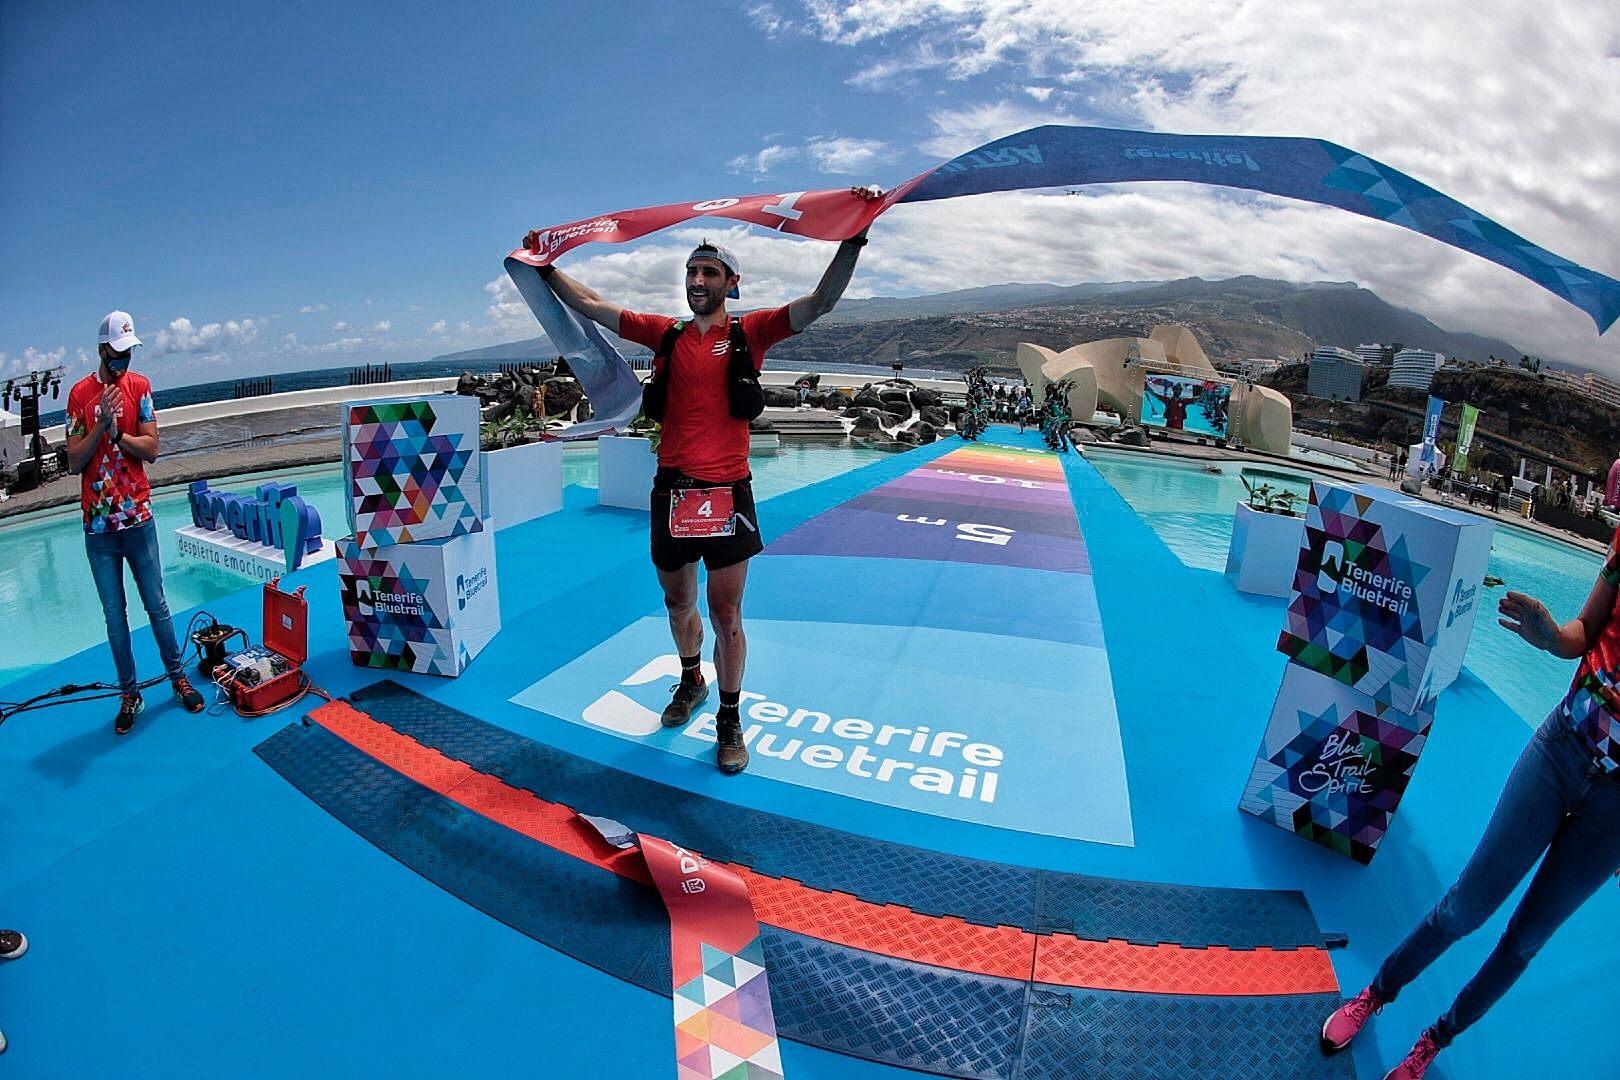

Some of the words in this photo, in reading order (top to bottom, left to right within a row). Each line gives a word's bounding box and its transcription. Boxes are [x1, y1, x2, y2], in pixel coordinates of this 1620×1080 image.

[550, 226, 618, 252] Bluetrail
[551, 217, 619, 240] Tenerife
[697, 500, 712, 518] 4
[178, 537, 220, 564] despierta
[1345, 560, 1412, 599] Tenerife
[372, 590, 424, 604] Tenerife
[374, 601, 425, 616] Bluetrail
[1341, 577, 1409, 617] Bluetrail
[738, 690, 1005, 768] Tenerife
[681, 712, 999, 803] Bluetrail
[1319, 730, 1366, 760] Blue
[1328, 752, 1377, 778] Trail
[1298, 763, 1374, 801] Spirit
